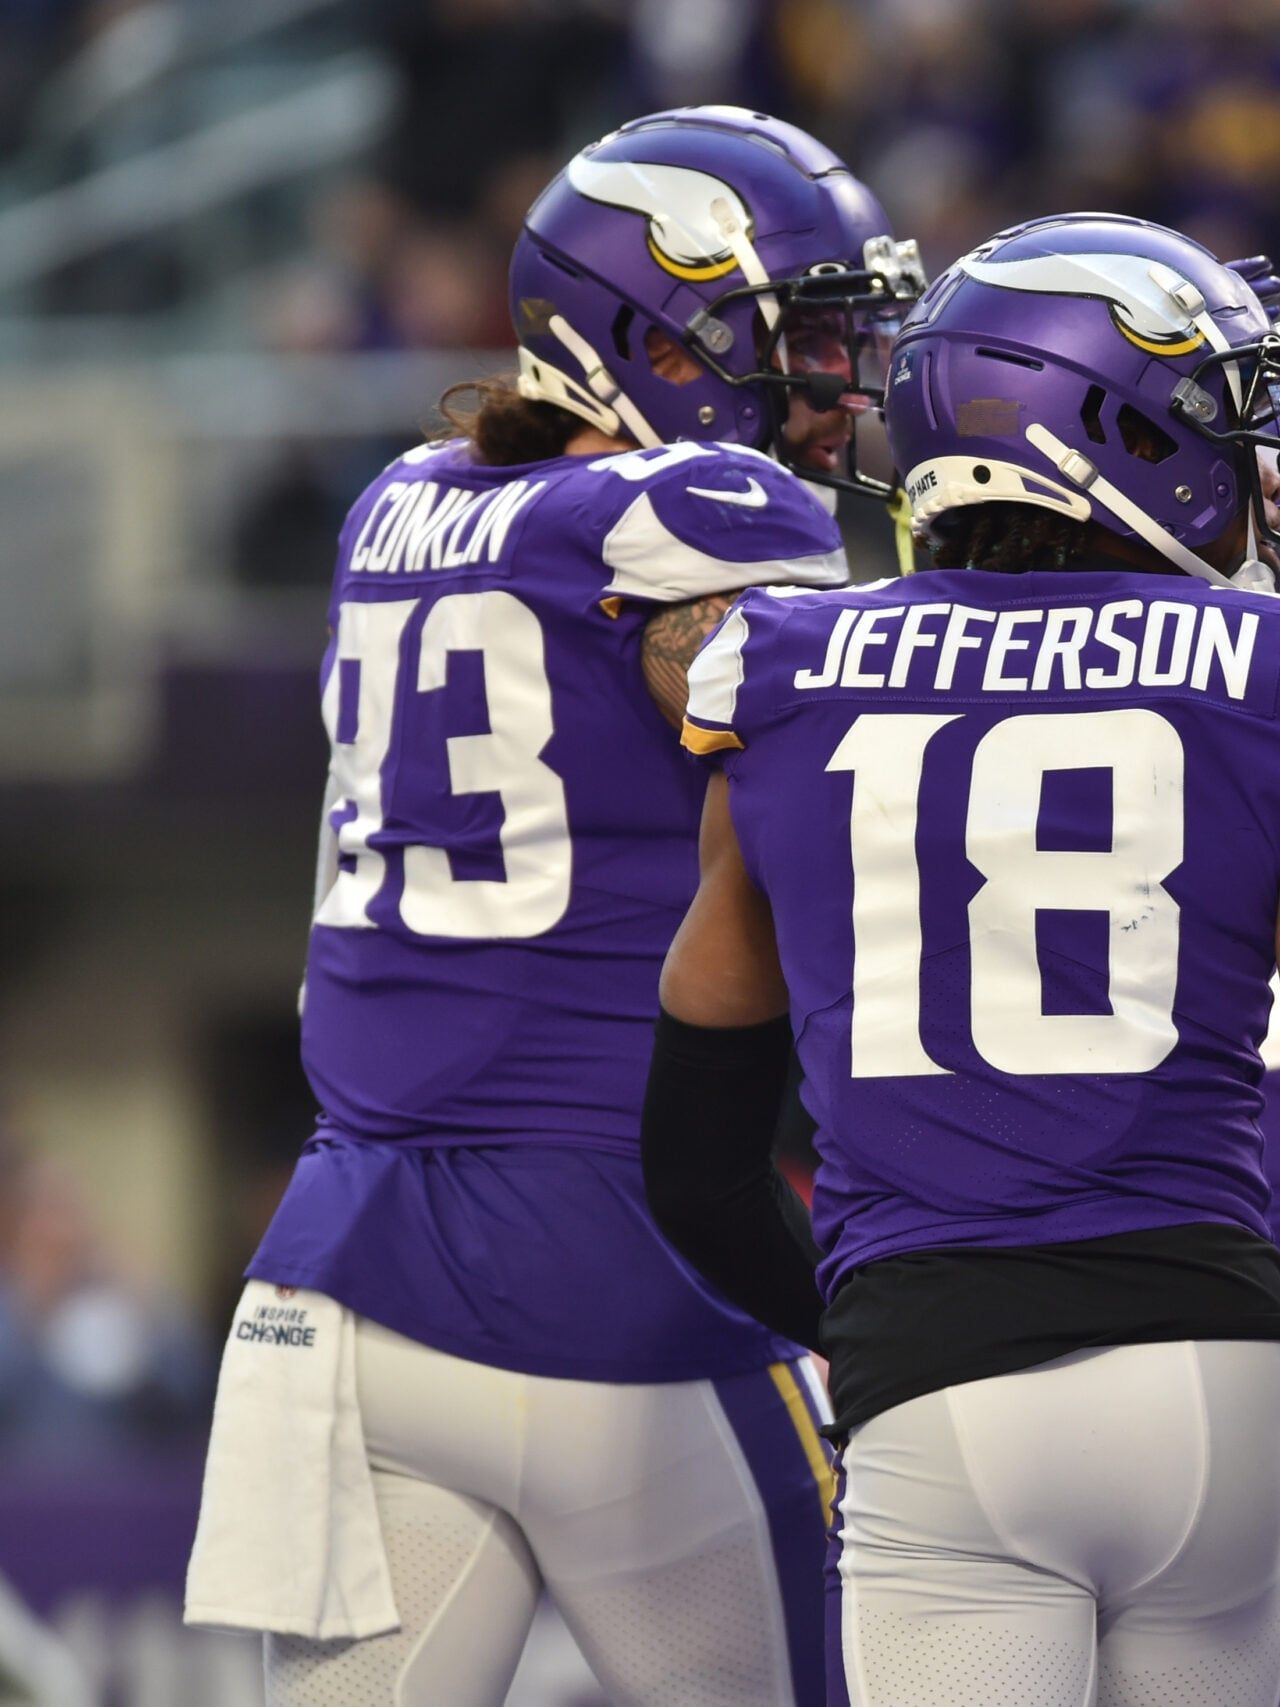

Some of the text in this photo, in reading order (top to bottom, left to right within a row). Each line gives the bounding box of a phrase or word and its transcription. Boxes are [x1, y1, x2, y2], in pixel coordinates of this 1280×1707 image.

[350, 480, 547, 574] CONKLIN
[915, 470, 938, 497] HATE
[794, 600, 1260, 700] JEFFERSON
[824, 708, 1184, 1078] 18
[254, 1305, 307, 1324] INSPIRE
